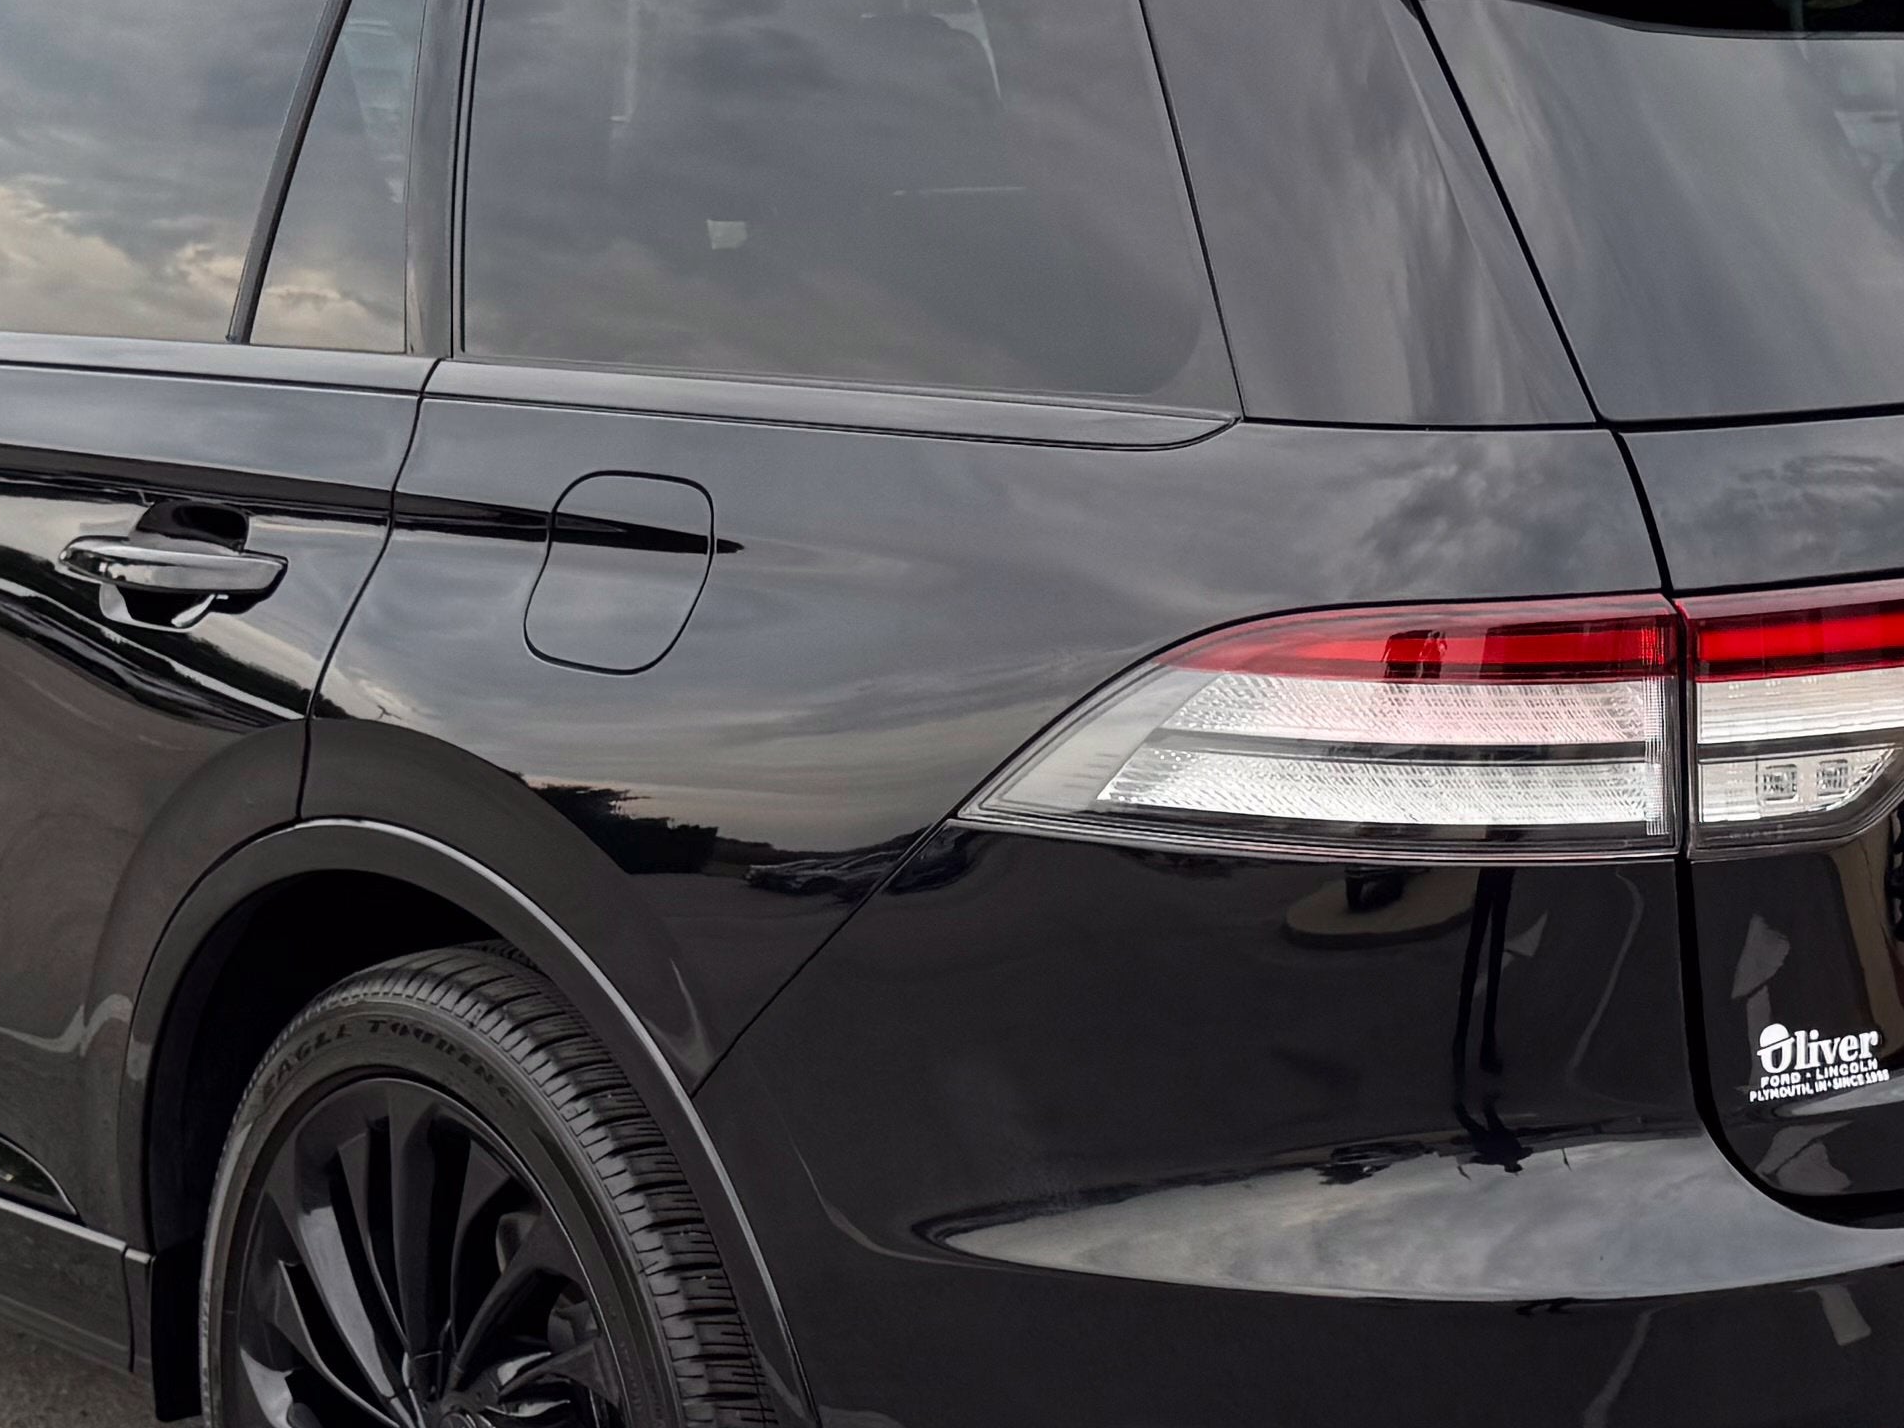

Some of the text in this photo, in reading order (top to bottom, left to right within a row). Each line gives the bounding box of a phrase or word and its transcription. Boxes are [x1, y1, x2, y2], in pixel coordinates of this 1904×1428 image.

[1757, 1023, 1879, 1074] Oliver
[1760, 1058, 1879, 1089] FORD LINCOLN
